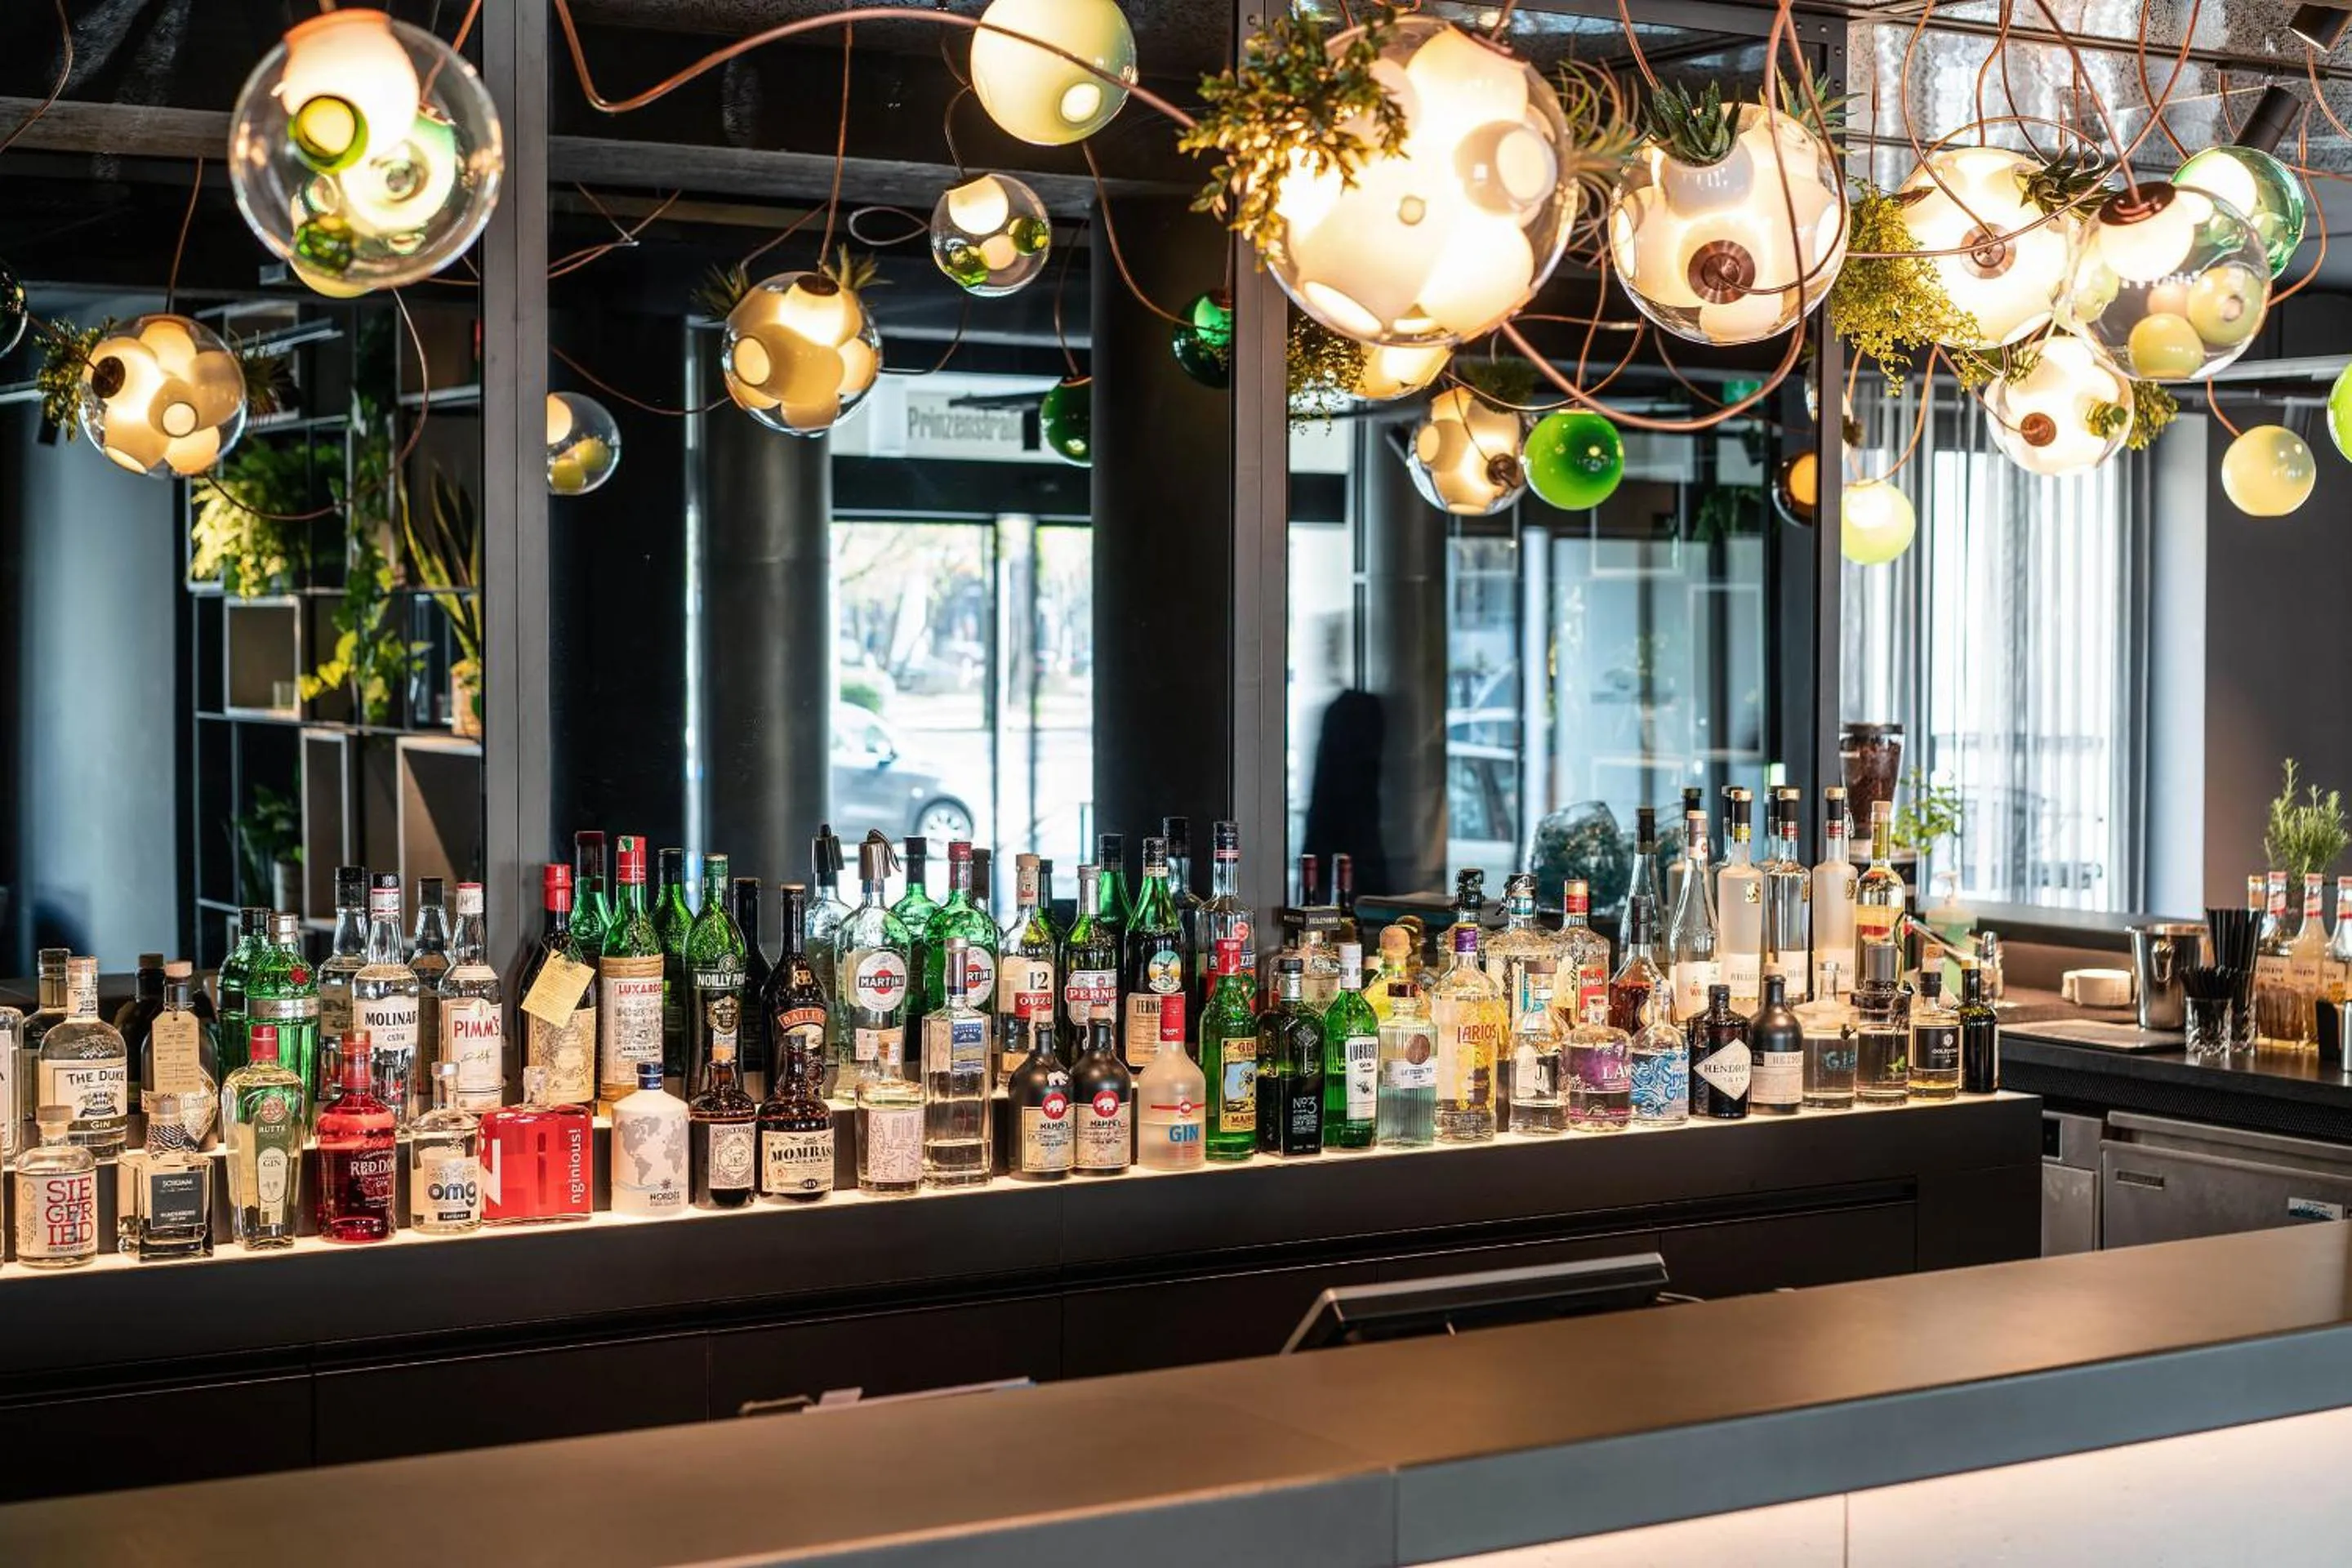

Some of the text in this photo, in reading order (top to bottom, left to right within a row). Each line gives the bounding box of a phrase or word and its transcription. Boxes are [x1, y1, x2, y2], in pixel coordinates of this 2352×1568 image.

[697, 973, 731, 987] NOILLY
[860, 975, 905, 987] MARTINI
[967, 969, 993, 981] RTINI
[1030, 971, 1048, 990] 12
[454, 1015, 499, 1038] PIMM'S
[1457, 1022, 1497, 1044] LARIOS
[65, 1070, 125, 1085] THE DUKE
[91, 1120, 110, 1129] GIN
[1169, 1124, 1199, 1143] GIN
[350, 1161, 376, 1176] RED
[568, 1128, 586, 1205] nginious!
[47, 1176, 92, 1203] SIE
[428, 1181, 477, 1207] omg
[47, 1223, 94, 1246] IED
